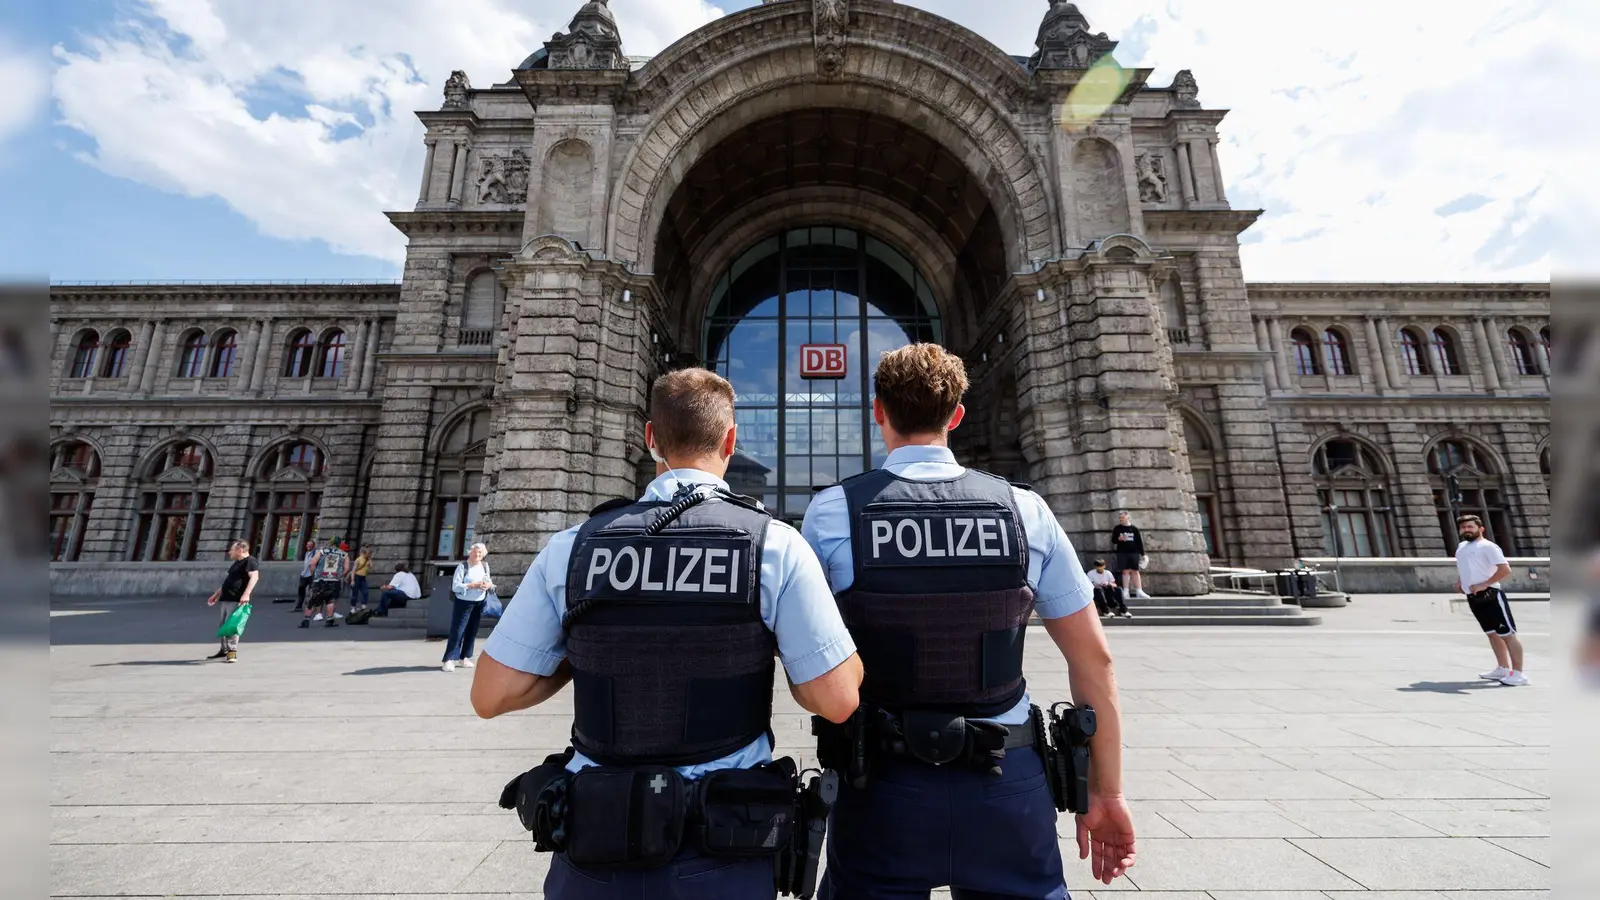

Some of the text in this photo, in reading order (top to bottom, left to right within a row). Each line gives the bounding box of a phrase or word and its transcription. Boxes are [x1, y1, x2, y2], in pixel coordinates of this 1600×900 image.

[807, 350, 843, 371] DB
[871, 517, 1010, 558] POLIZEI
[585, 545, 740, 593] POLIZEI
